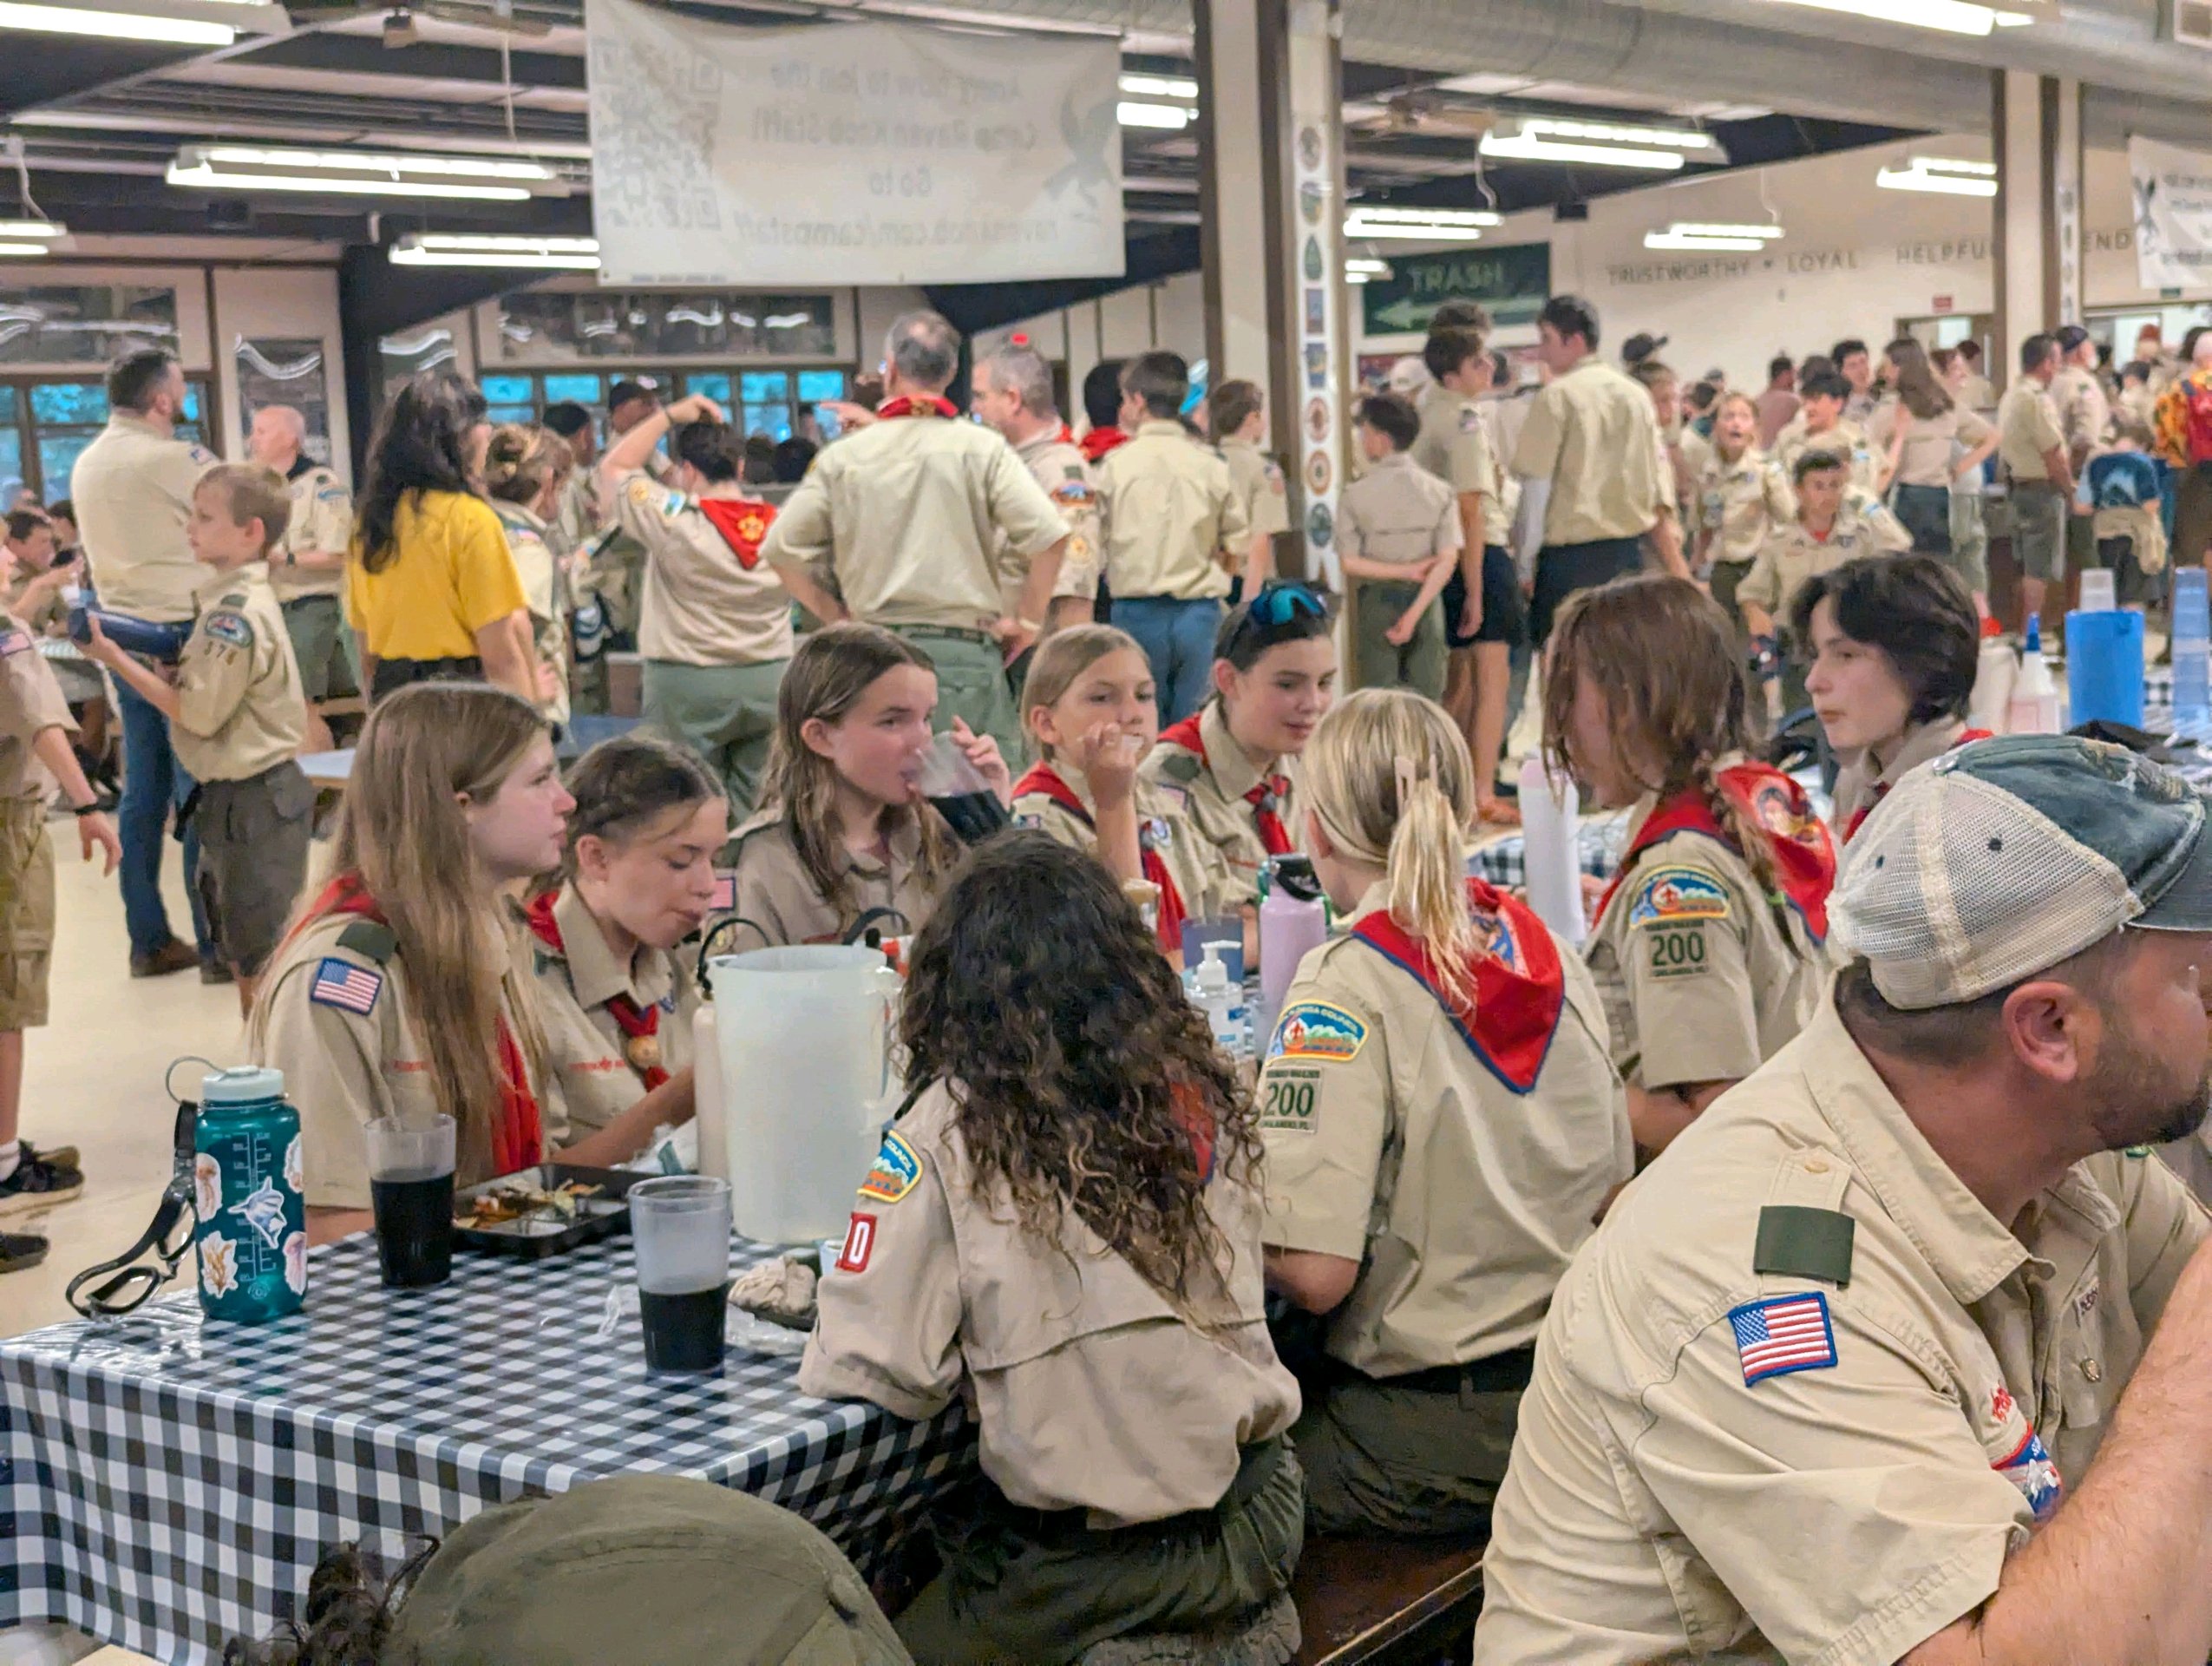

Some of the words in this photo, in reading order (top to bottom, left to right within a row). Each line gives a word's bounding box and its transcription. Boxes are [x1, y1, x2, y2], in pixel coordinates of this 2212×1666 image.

[1406, 262, 1505, 292] TRASH
[1607, 259, 1751, 285] TRUSTWORTHY
[1787, 251, 1858, 272] LOYAL
[1651, 931, 1705, 966] 200
[1263, 1082, 1315, 1118] 200
[847, 1221, 871, 1264] 0
